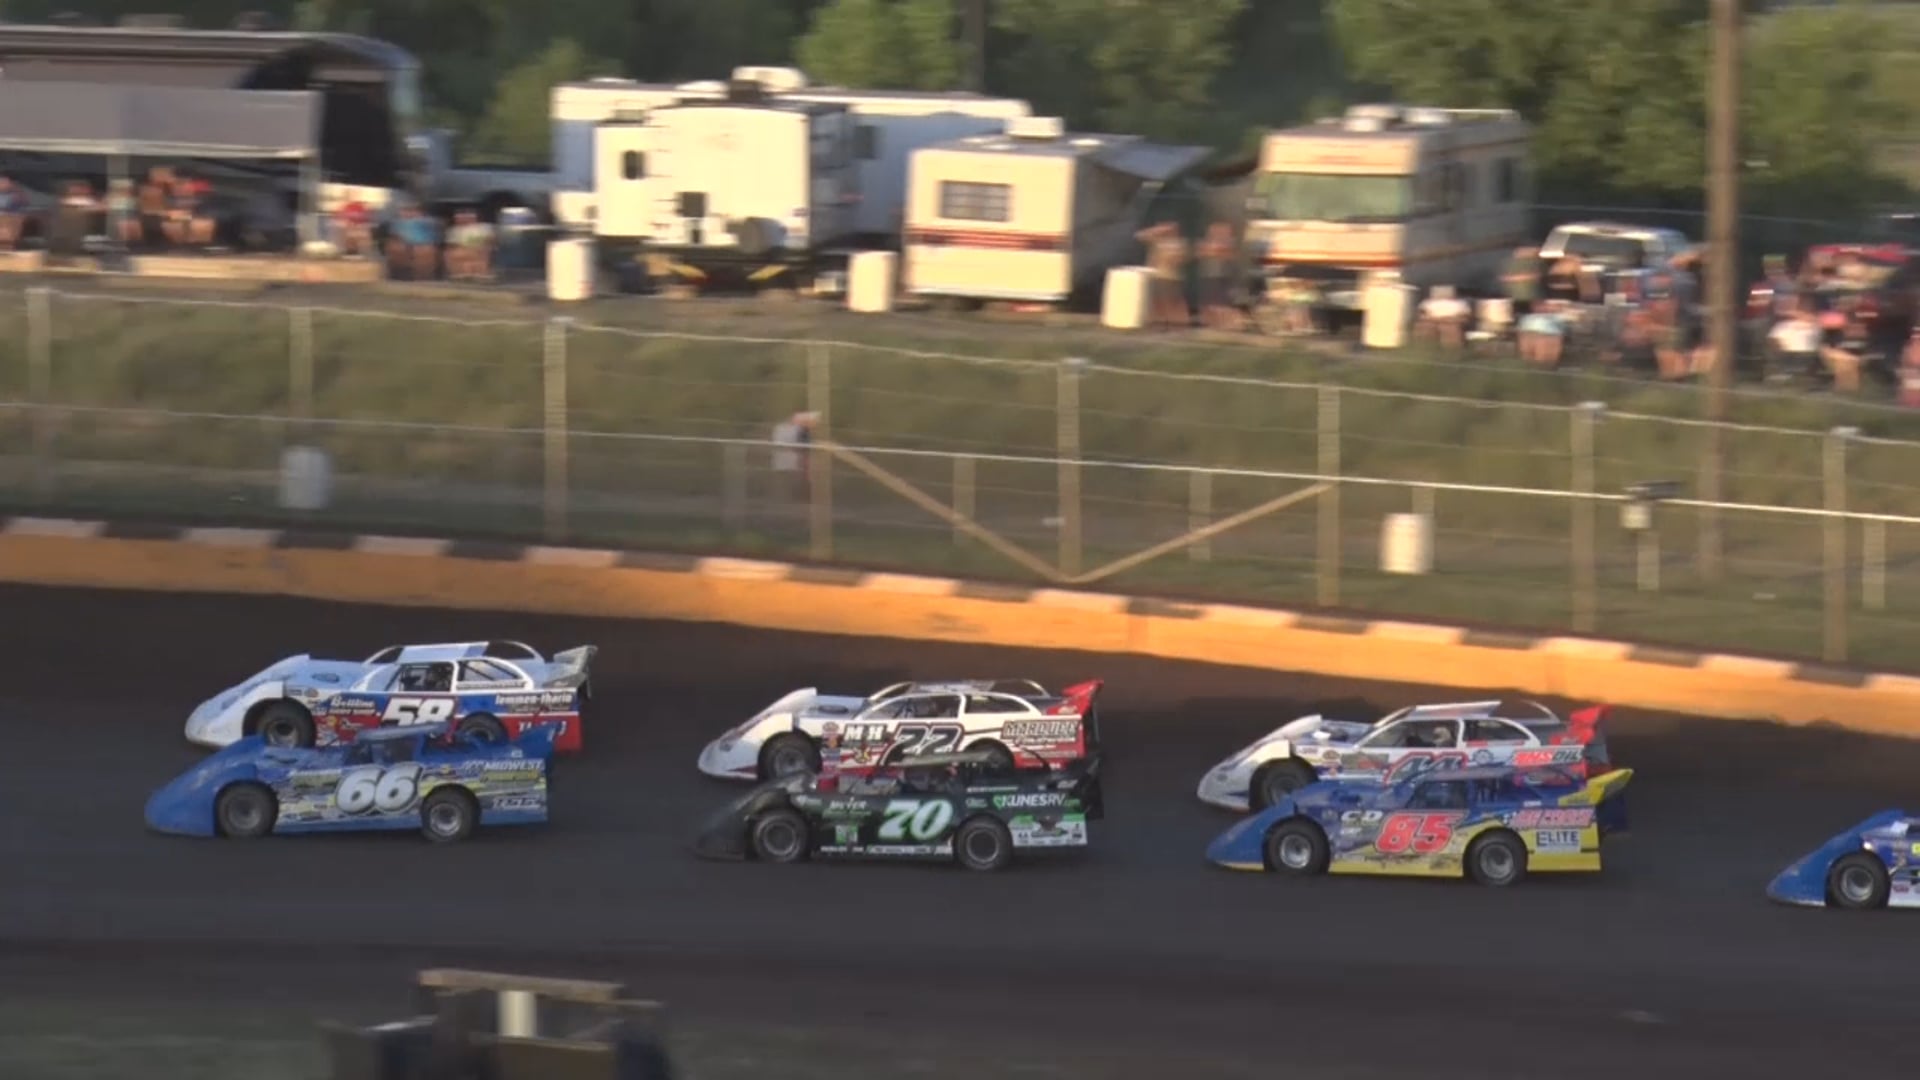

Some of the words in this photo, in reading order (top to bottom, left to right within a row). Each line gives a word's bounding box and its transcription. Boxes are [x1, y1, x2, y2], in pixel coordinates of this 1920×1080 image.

[336, 761, 422, 815] 66
[878, 800, 952, 839] 70
[1375, 812, 1462, 854] 85
[1537, 831, 1579, 846] ELITE
